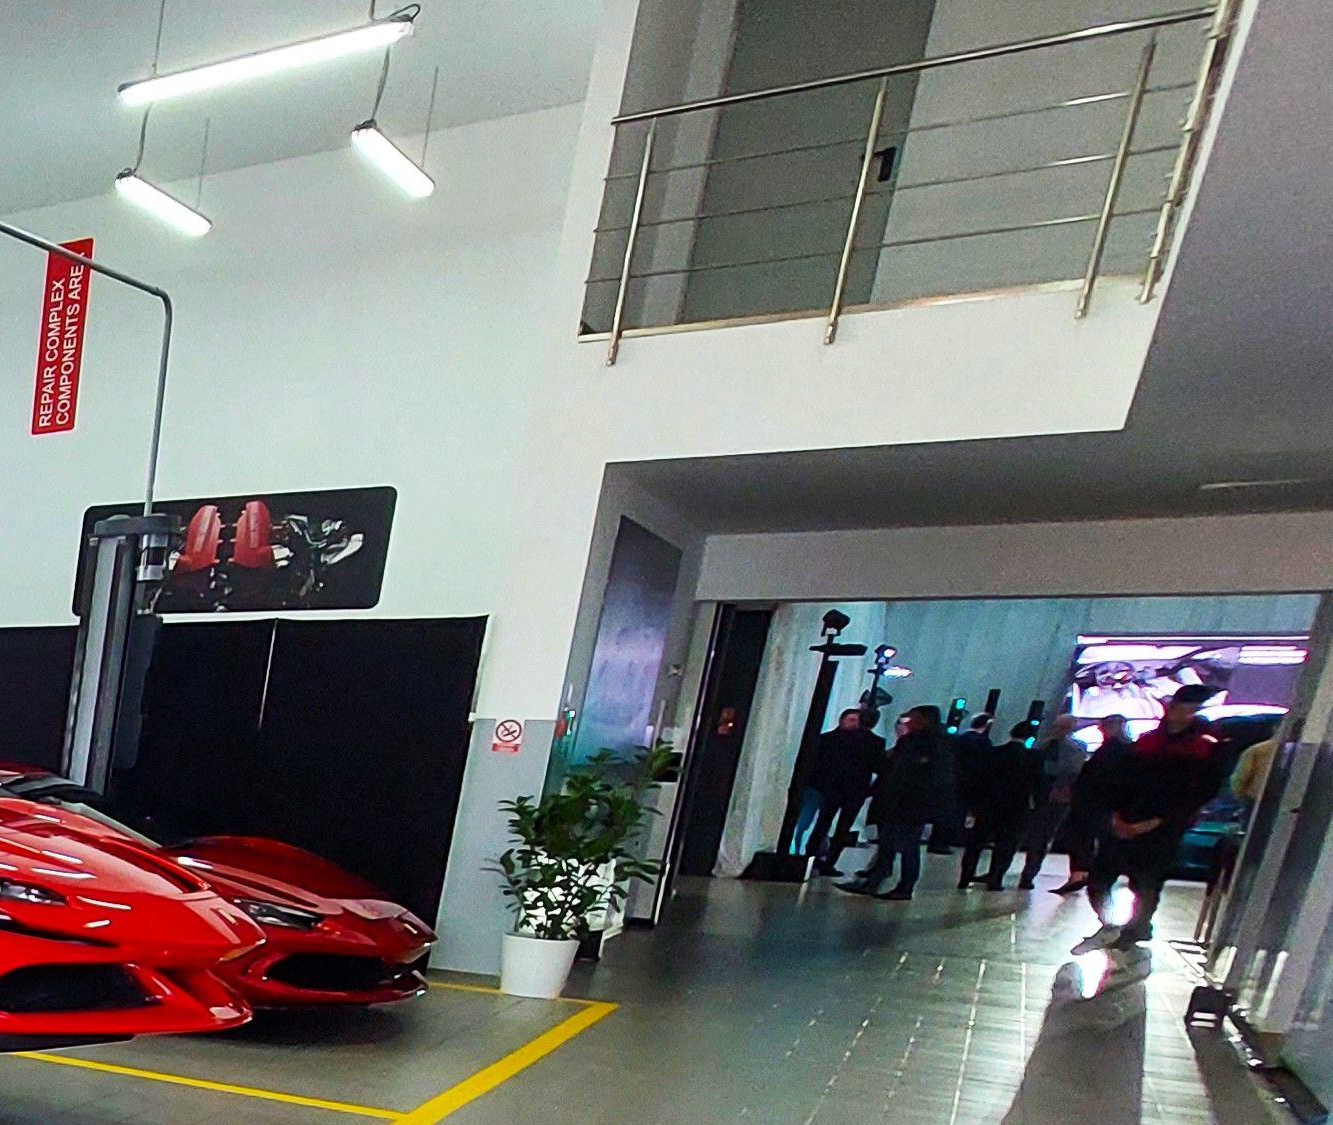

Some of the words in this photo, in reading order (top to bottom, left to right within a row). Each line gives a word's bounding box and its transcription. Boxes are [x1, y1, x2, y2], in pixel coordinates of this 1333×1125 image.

[45, 277, 66, 362] COMPLEX
[38, 365, 58, 427] REPAIR
[55, 303, 80, 425] COMPONENTS
